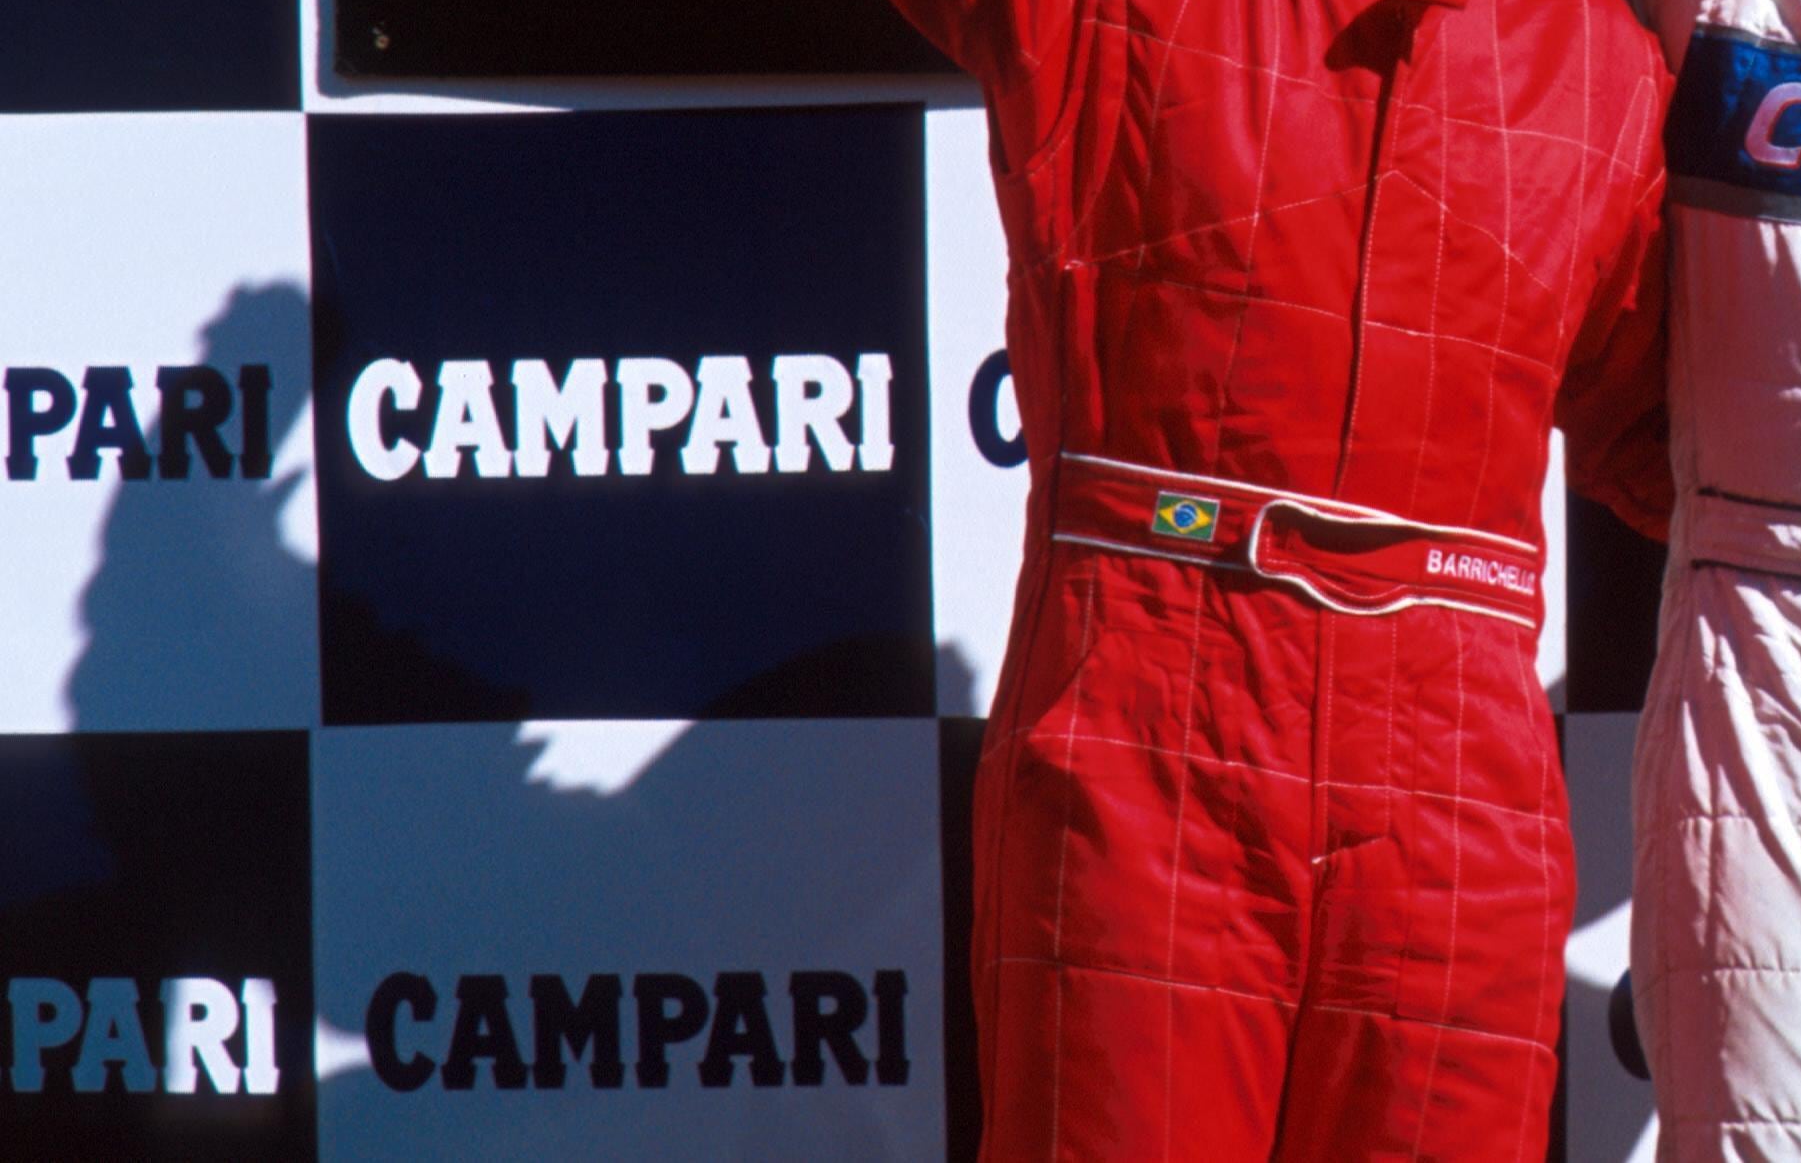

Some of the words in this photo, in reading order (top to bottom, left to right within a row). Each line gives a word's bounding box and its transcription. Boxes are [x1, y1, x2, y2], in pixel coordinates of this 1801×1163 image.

[3, 364, 273, 481] PARI
[346, 352, 894, 481] CAMPARI
[7, 977, 280, 1094] PARI
[366, 969, 911, 1092] CAMPARI
